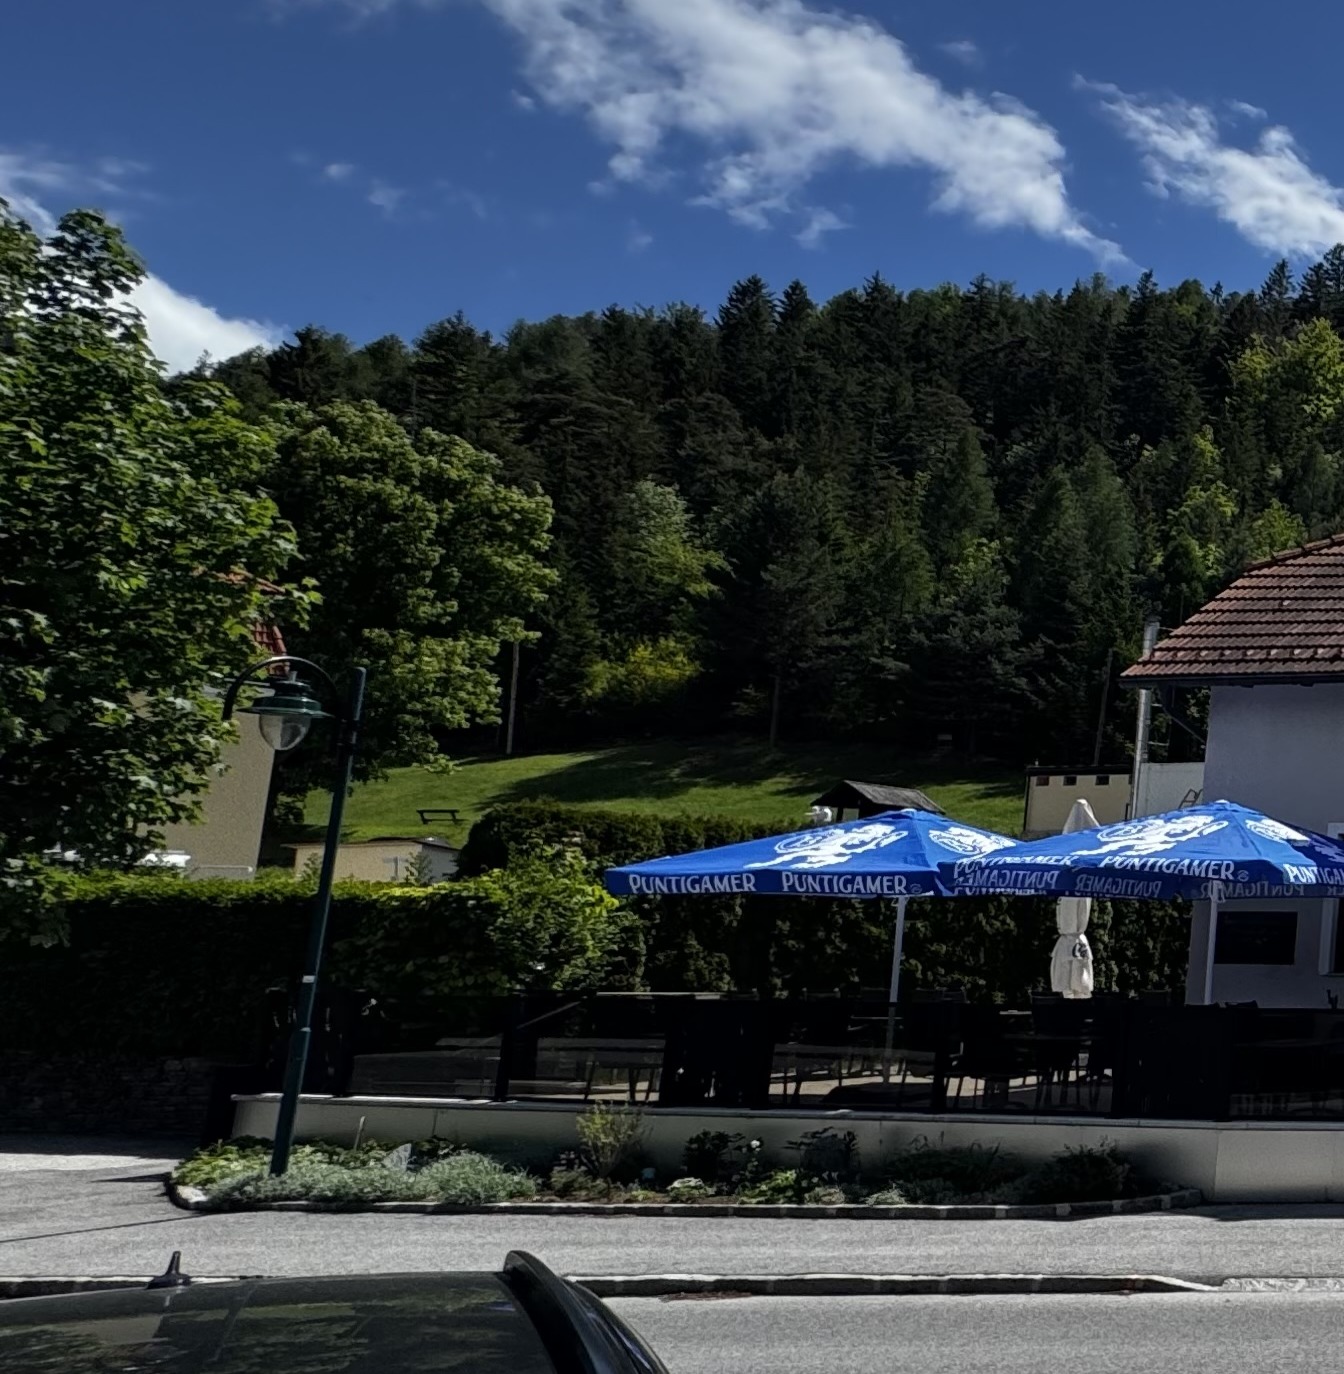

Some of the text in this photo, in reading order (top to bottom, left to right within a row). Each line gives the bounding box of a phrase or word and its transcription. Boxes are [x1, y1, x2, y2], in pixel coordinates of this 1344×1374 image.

[1097, 855, 1235, 880] PUNTIGAMER
[628, 872, 756, 894] PUNTIGAMER
[780, 871, 907, 895] PUNTIGAMER
